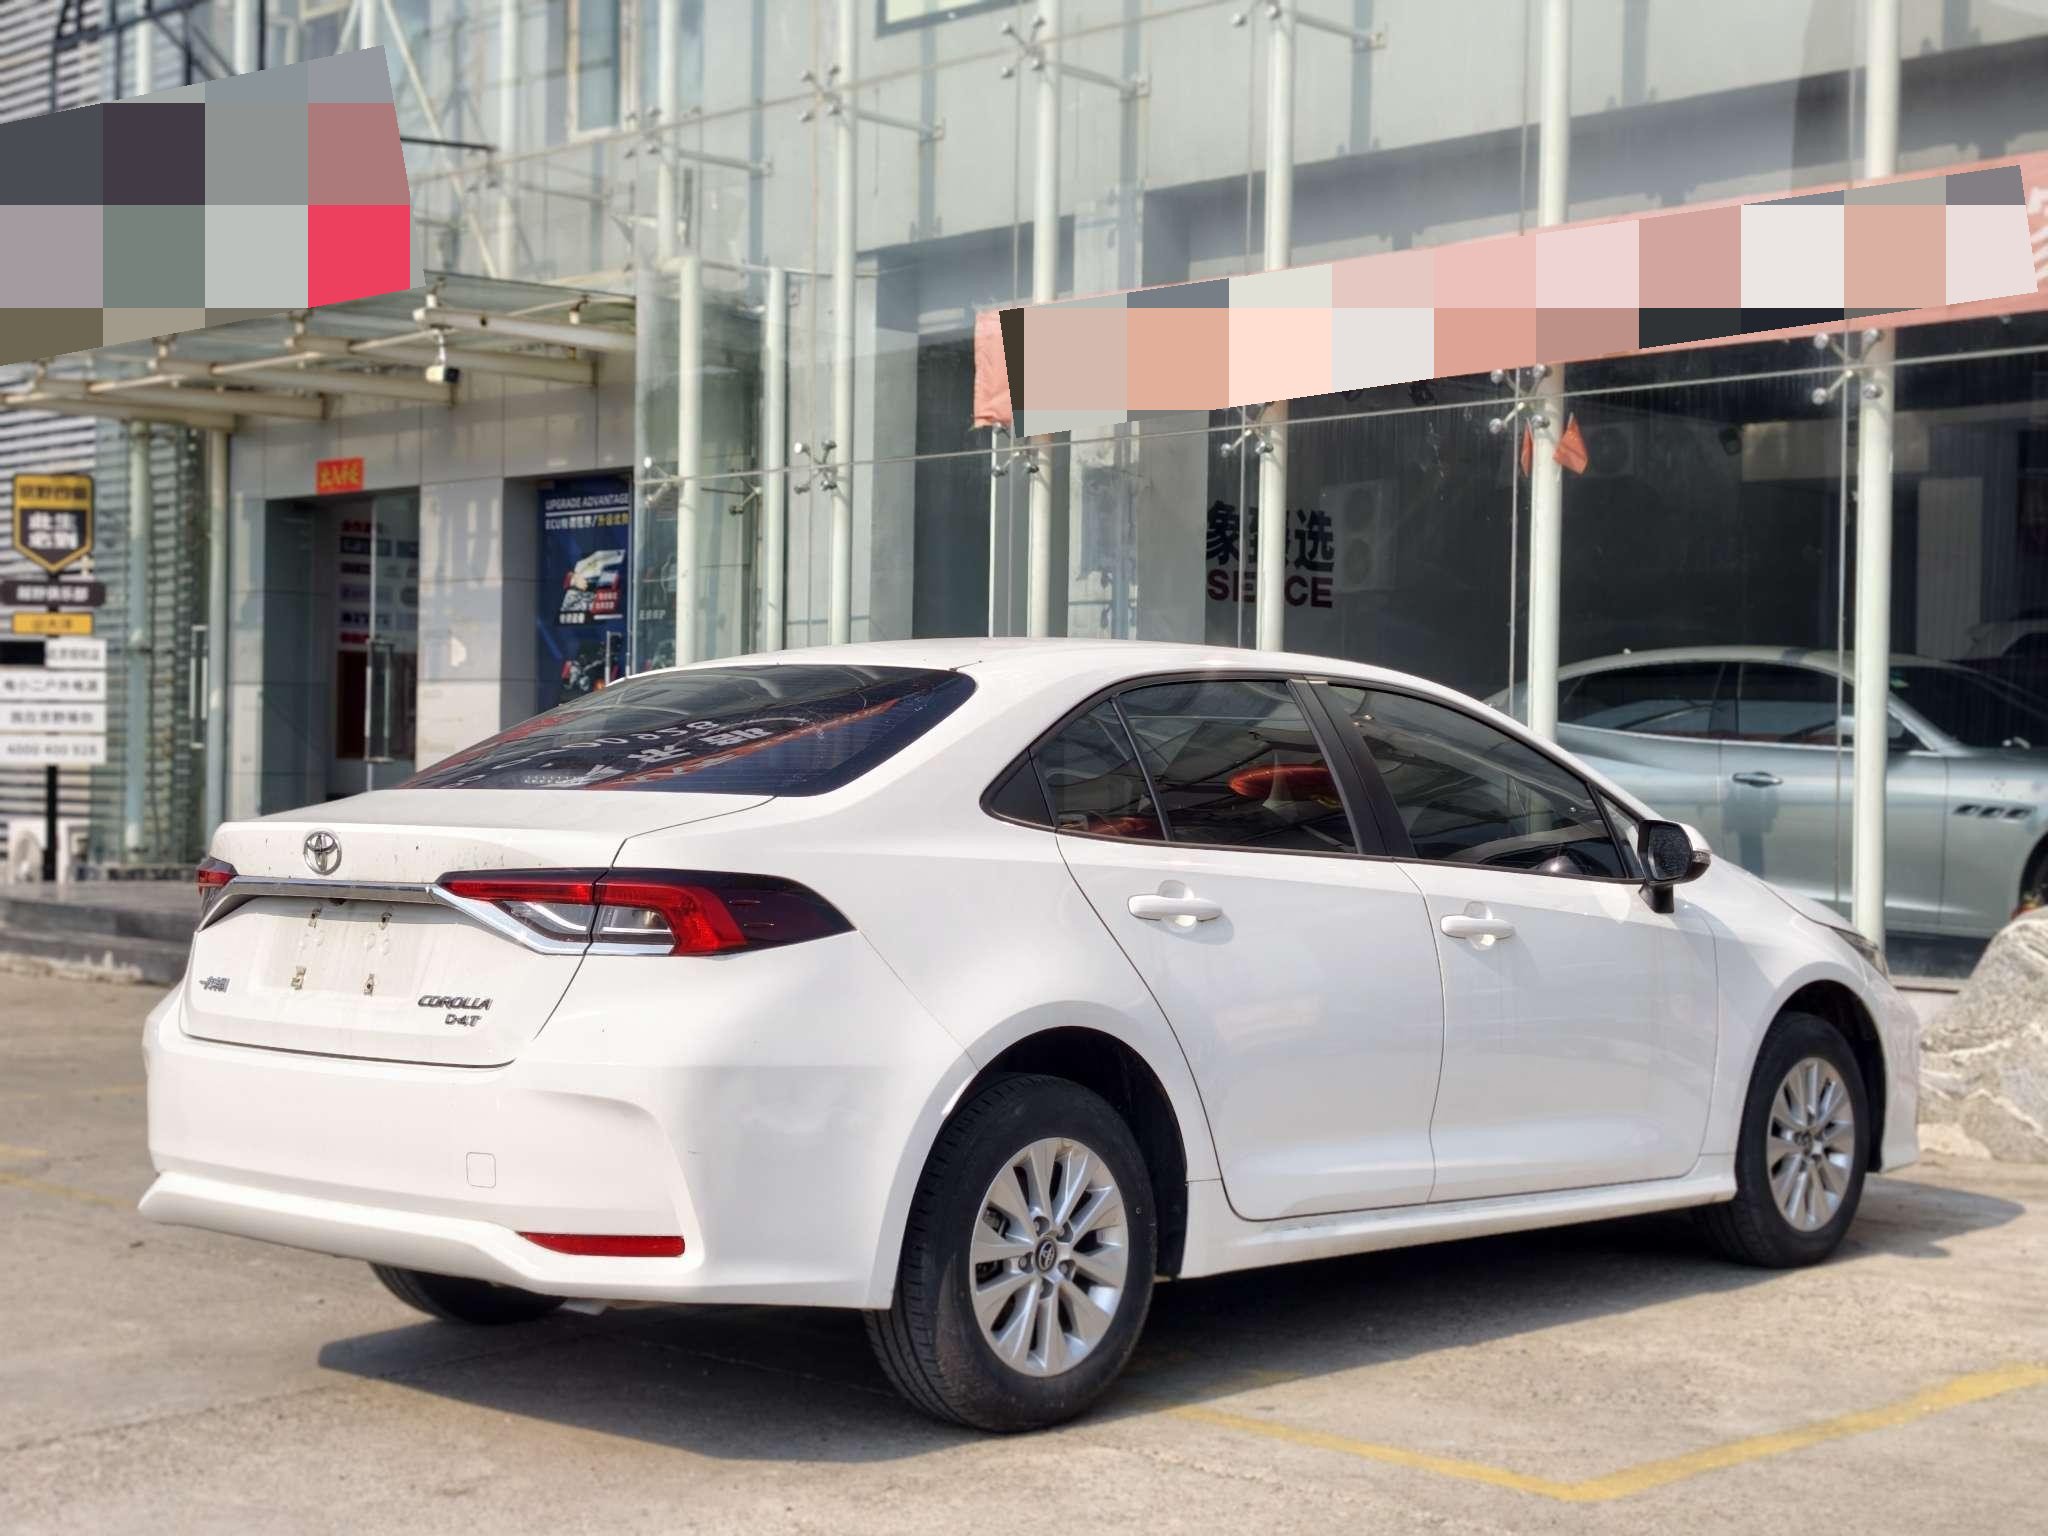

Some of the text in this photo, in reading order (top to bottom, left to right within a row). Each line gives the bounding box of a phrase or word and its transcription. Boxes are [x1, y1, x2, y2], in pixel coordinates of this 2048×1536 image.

[545, 492, 629, 511] UPGRADE ADVANTAGE
[417, 995, 493, 1010] COROLLA
